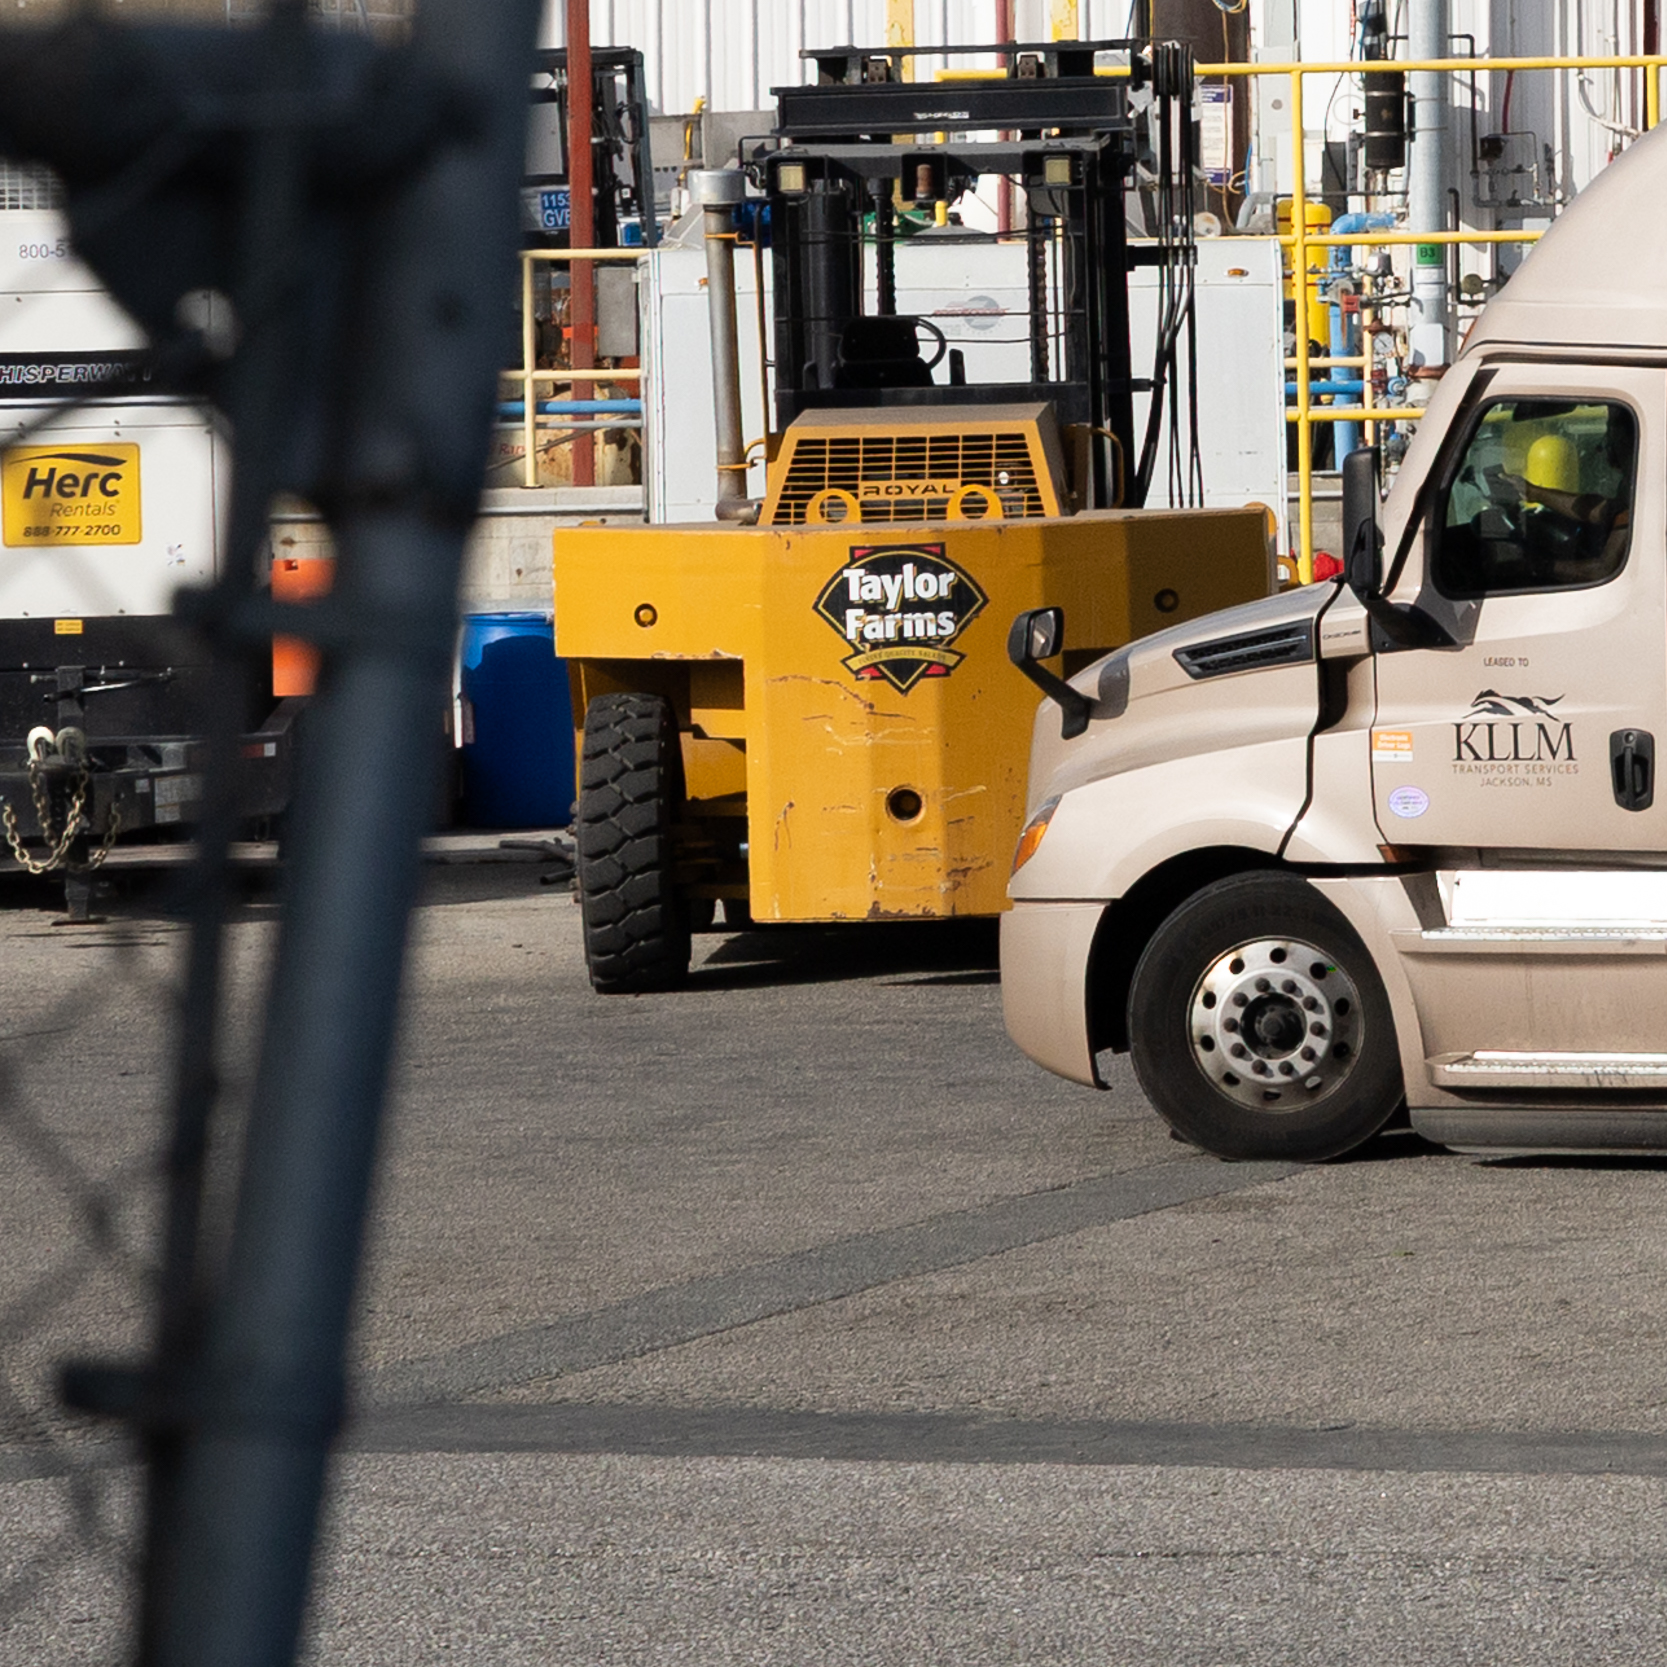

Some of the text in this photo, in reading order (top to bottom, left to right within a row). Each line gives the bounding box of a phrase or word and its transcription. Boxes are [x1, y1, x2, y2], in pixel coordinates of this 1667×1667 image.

[19, 243, 67, 259] 800-5
[23, 467, 123, 500] Herc
[863, 483, 956, 496] ROYAL
[49, 501, 117, 518] Rentals
[23, 524, 122, 539] 888-777-2700
[843, 562, 957, 610] Taylor
[845, 608, 957, 641] Farms
[1483, 657, 1529, 667] LEASED TO
[1451, 722, 1578, 761] KLLM
[1452, 764, 1580, 774] TRANSPORT SERVICES
[1479, 776, 1553, 788] JACKSON, MS
